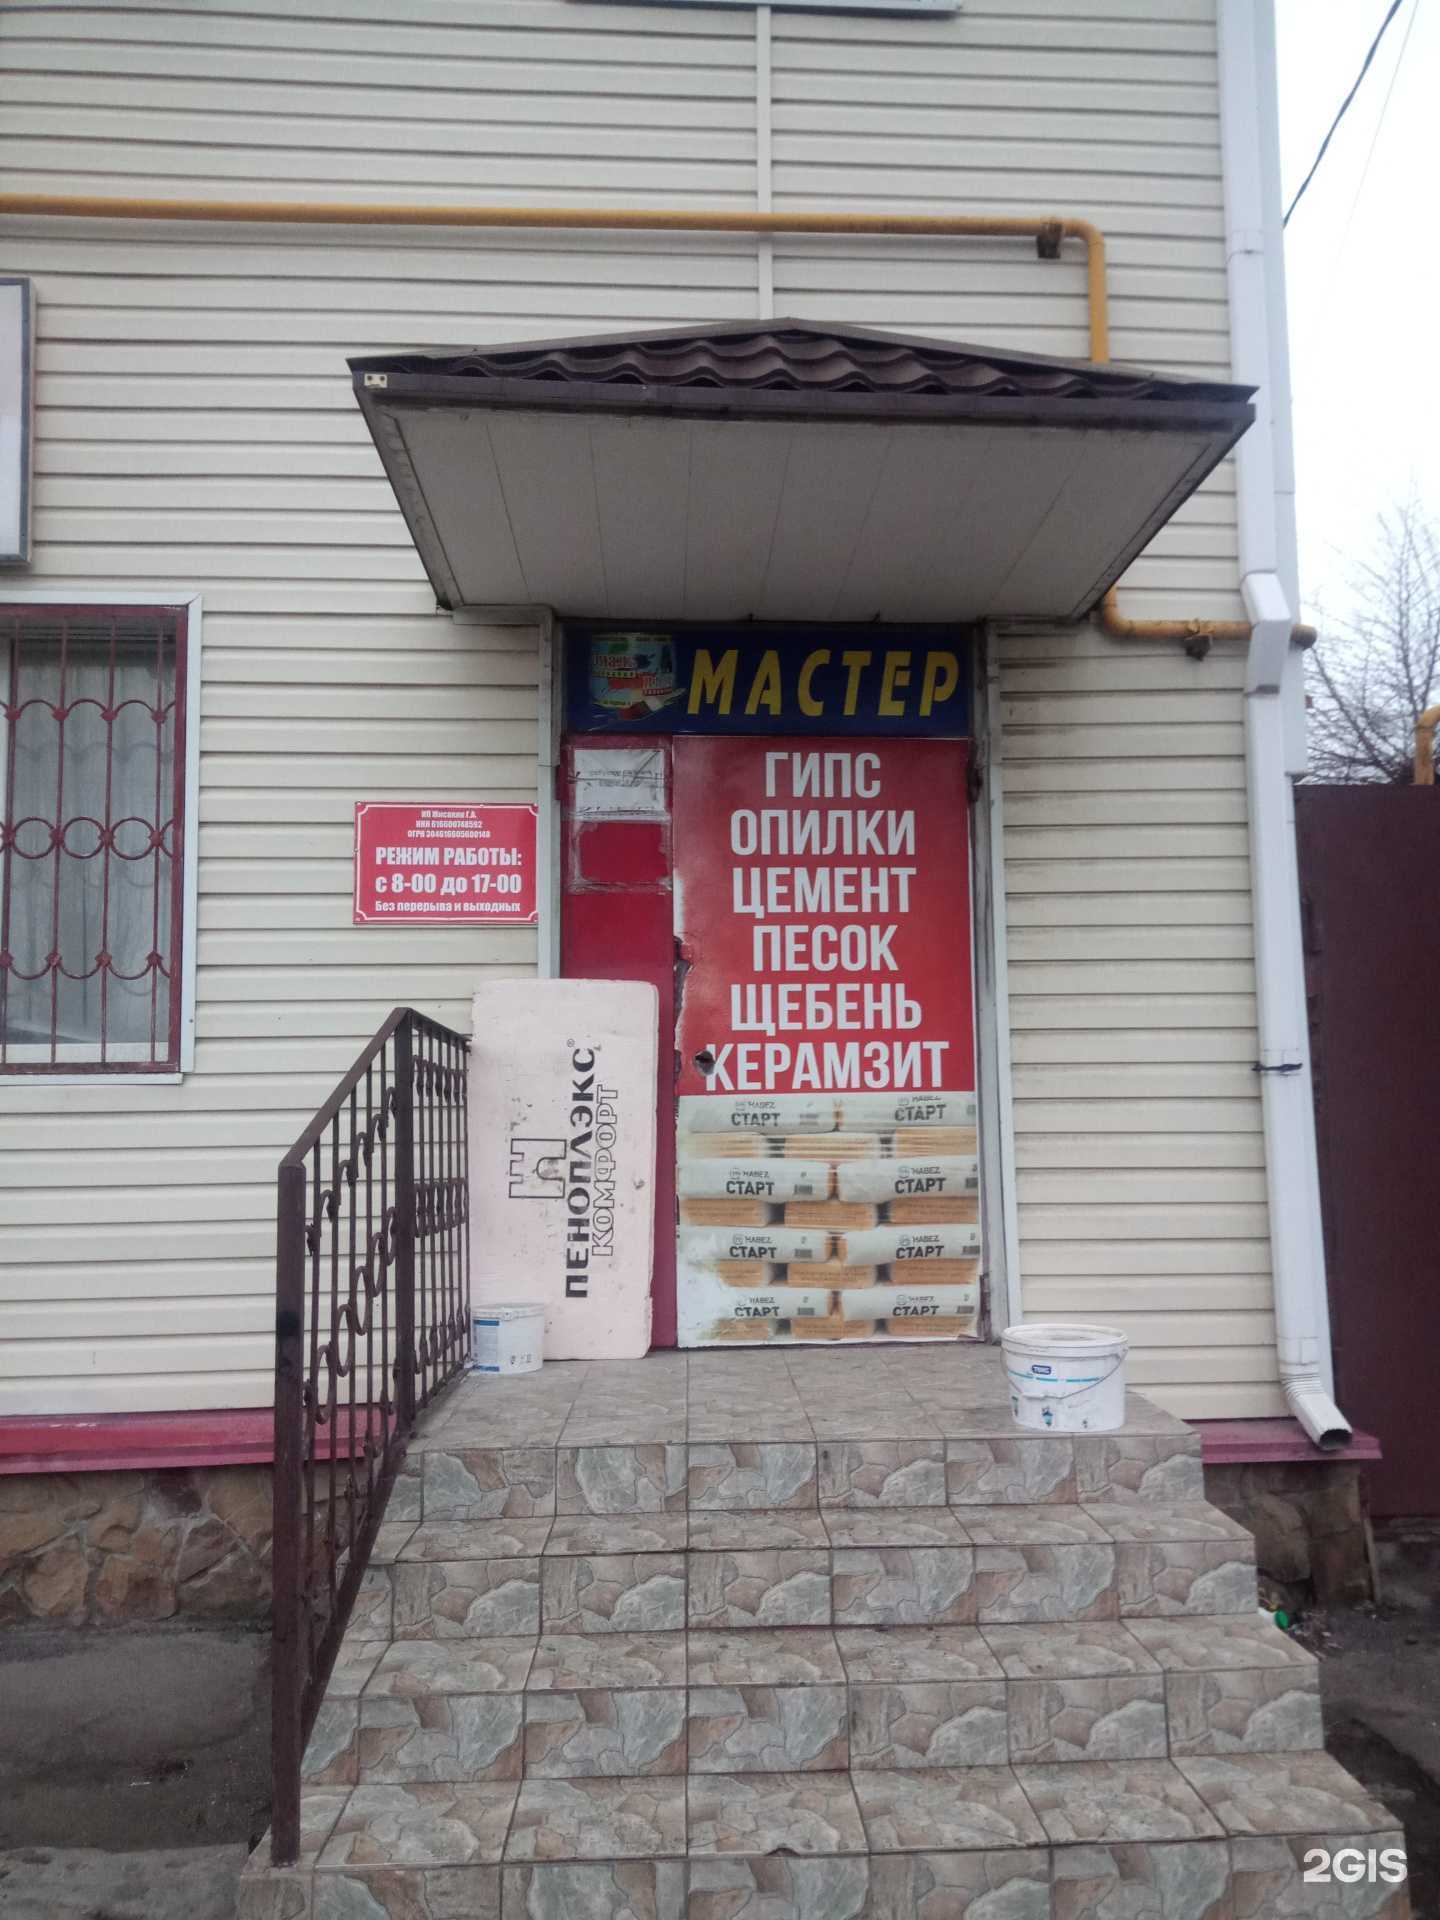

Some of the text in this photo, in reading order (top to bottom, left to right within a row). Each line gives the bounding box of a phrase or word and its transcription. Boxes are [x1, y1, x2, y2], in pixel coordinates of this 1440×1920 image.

[687, 648, 959, 716] МАСТЕР
[765, 751, 881, 798] ГИПС
[730, 809, 916, 856] ОПИЛКИ
[375, 847, 522, 866] РЕЖИМ РАБОТЫ:
[375, 873, 522, 895] с 8-00 до 17-00
[732, 867, 917, 919] ЦЕМЕНТ
[375, 900, 520, 912] Без перерыва и выходных
[753, 925, 899, 972] ПЕСОК
[730, 983, 922, 1036] ЩЕБЕНЬ
[705, 1041, 949, 1091] КЕРАМЗИТ
[731, 1113, 780, 1126] СТАРТ
[895, 1104, 946, 1121] СТАРТ
[566, 1047, 596, 1298] ПЕНОПЛЭКС
[592, 1084, 618, 1256] КОМФОРТ
[726, 1181, 775, 1195] СТАРТ
[895, 1178, 946, 1193] СТАРТ
[730, 1246, 777, 1258] СТАРТ
[896, 1246, 944, 1259] СТАРТ
[735, 1307, 779, 1317] СТАРТ
[893, 1305, 939, 1316] СТАРТ
